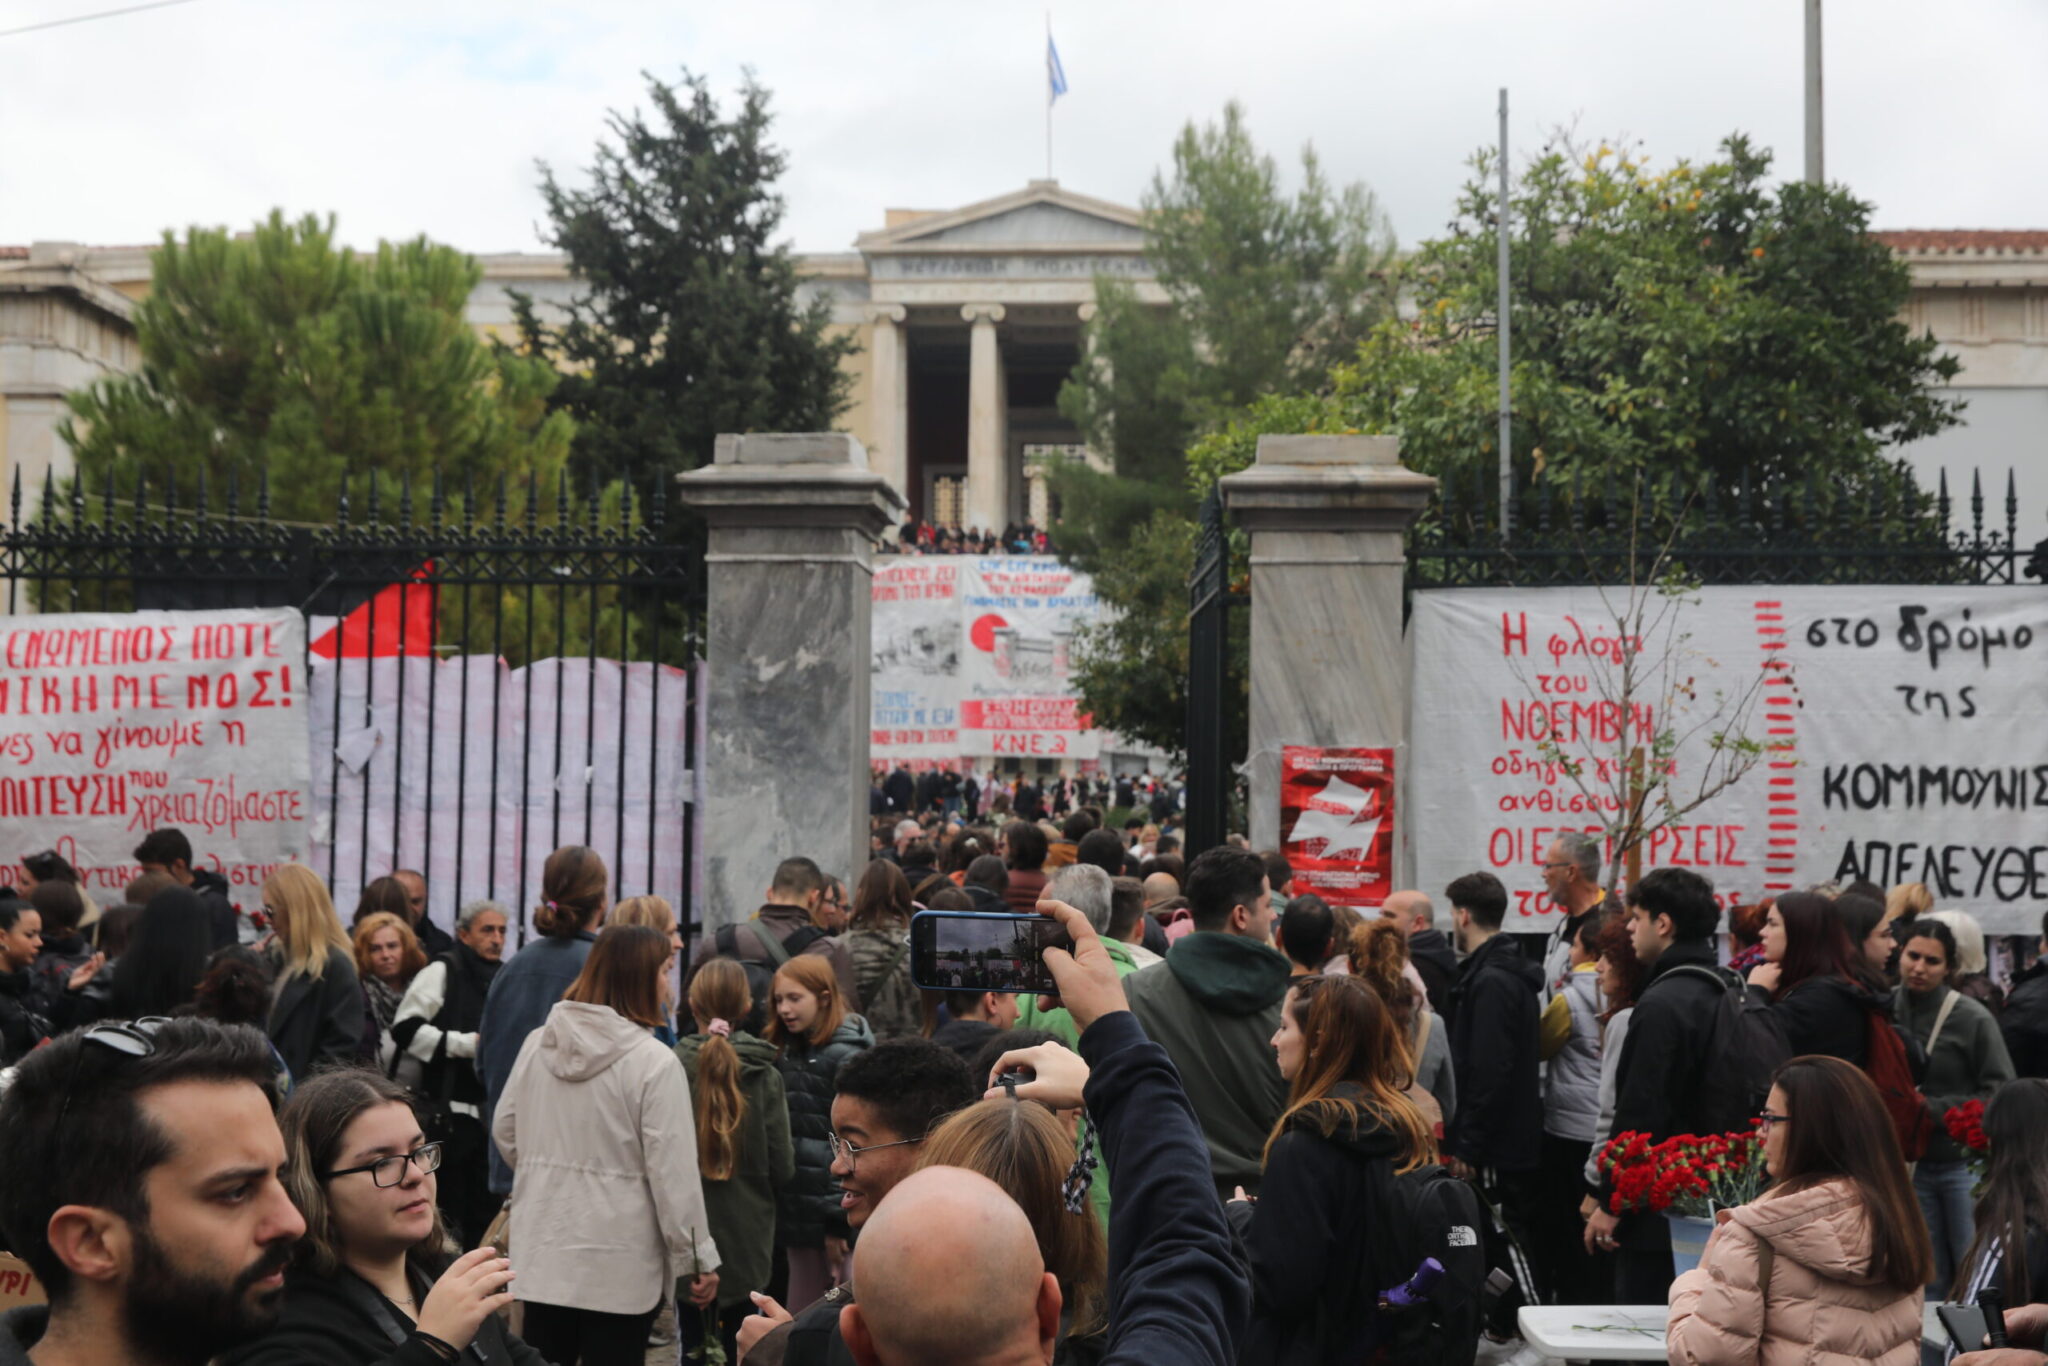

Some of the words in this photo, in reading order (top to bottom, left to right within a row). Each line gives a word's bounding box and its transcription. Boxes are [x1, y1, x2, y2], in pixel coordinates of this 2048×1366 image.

[192, 621, 284, 661] ΠΟΤΕ
[1502, 611, 1528, 656] Η
[1806, 618, 1879, 648] στο
[1897, 605, 2033, 671] δρόμο
[1536, 673, 1588, 694] του
[1895, 684, 1977, 719] της
[45, 731, 83, 756] να
[94, 716, 205, 769] γίνουμε
[220, 720, 246, 747] η
[127, 769, 169, 789] που
